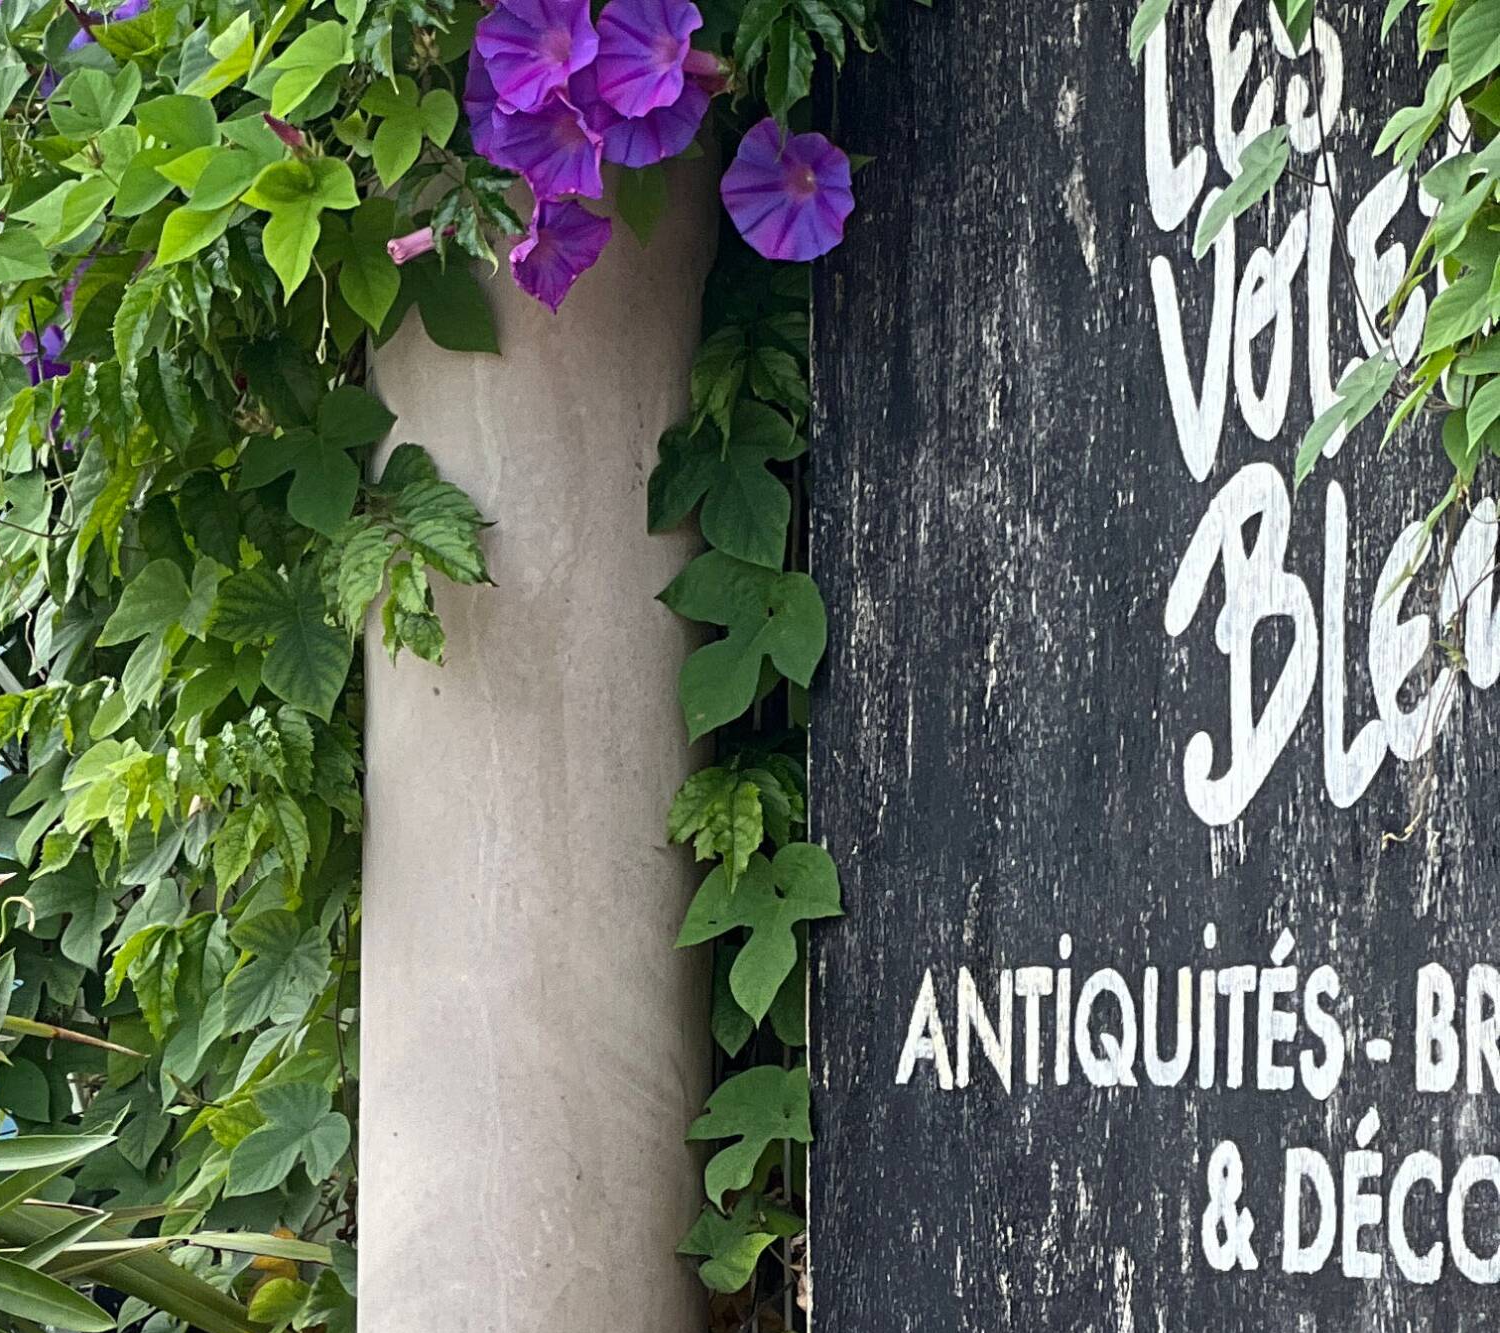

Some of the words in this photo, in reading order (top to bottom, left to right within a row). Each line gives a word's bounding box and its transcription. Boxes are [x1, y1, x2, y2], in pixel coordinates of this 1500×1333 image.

[1416, 962, 1500, 1094] BR
[1201, 1140, 1258, 1271] &
[1282, 1106, 1500, 1285] DÉCO
